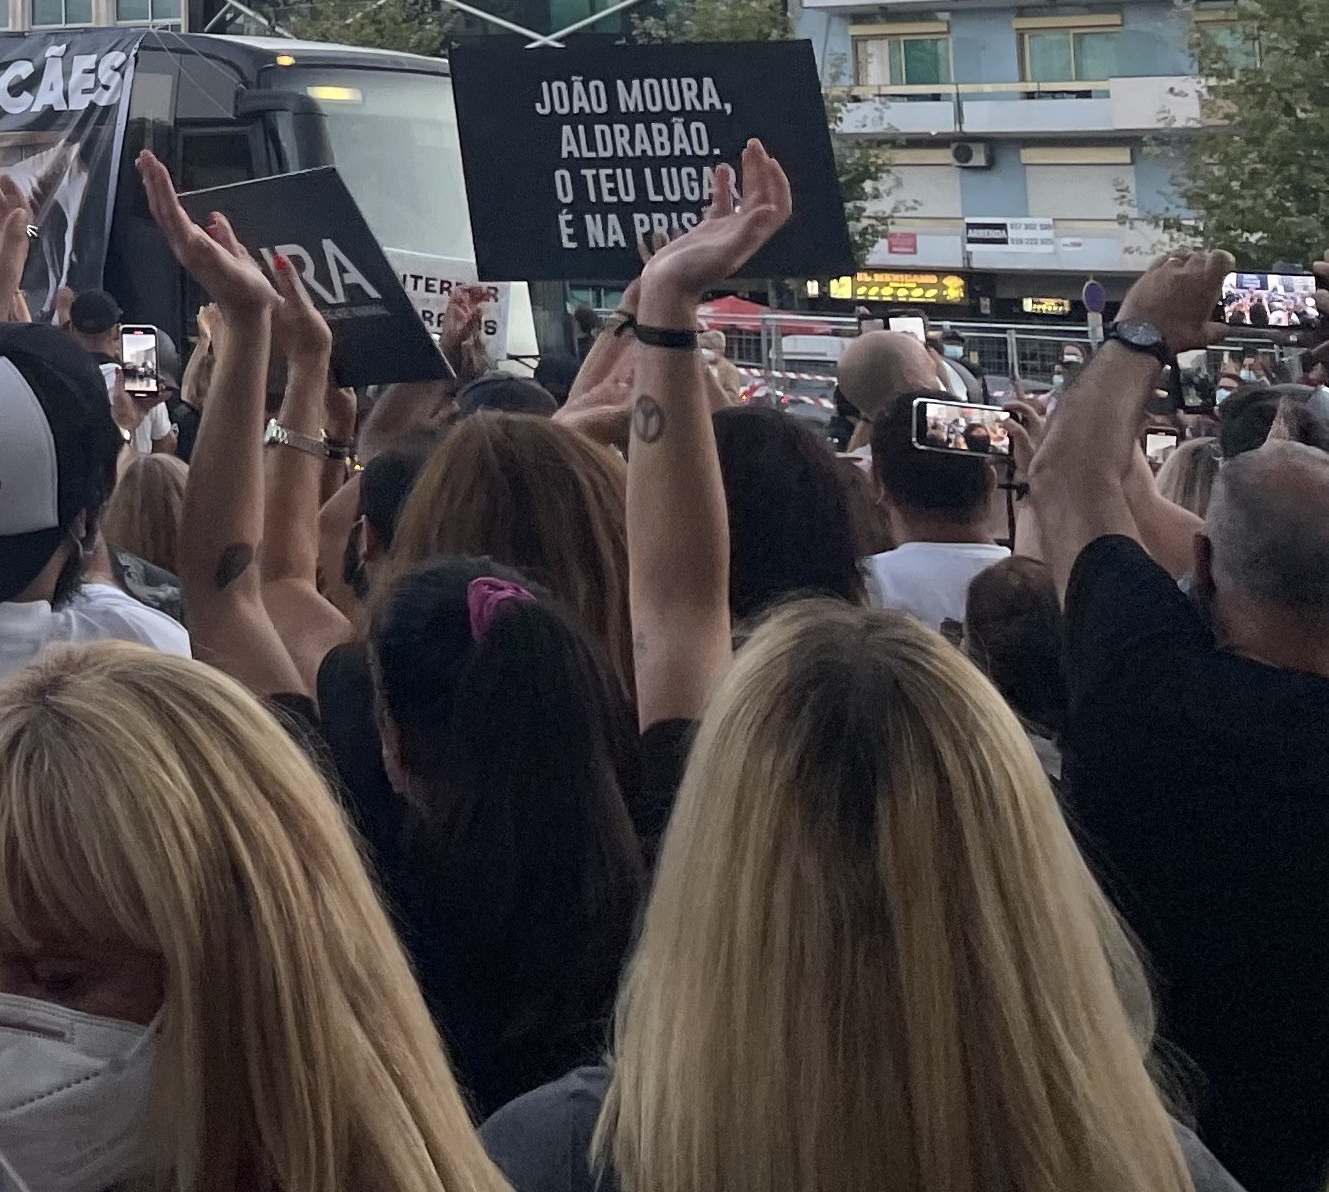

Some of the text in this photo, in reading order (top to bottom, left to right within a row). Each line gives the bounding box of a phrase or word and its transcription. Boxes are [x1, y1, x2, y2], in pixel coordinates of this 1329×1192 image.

[534, 75, 733, 116] JOÃO MOURA,
[561, 116, 721, 159] ALDRABÃO.
[554, 168, 574, 204] O
[580, 167, 637, 203] TEU
[558, 209, 578, 249] É
[585, 212, 627, 249] NA
